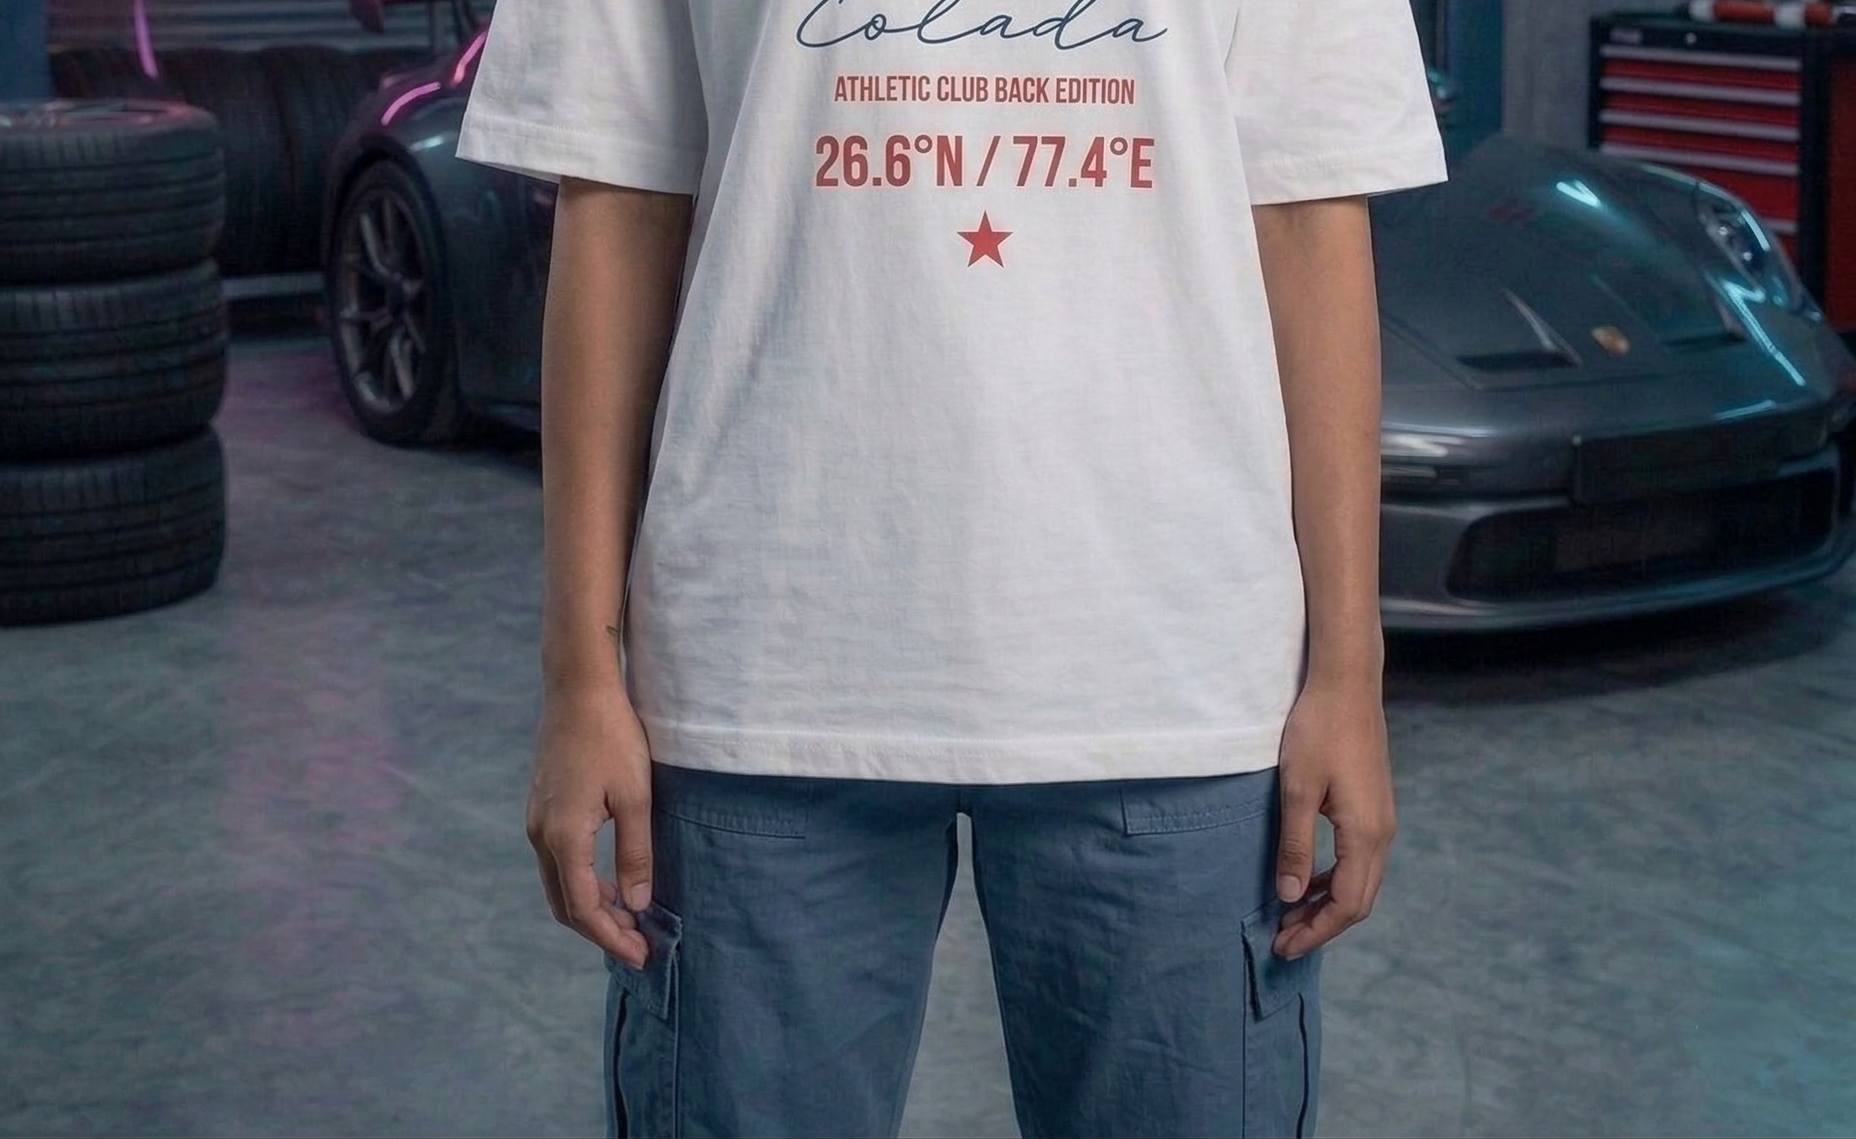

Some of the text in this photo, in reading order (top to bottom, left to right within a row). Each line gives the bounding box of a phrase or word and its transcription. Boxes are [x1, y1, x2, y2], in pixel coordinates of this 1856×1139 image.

[833, 75, 1135, 105] ATHLETIC CLUB BACK EDITION
[815, 134, 1155, 189] 26.6°N / 77.4°E
